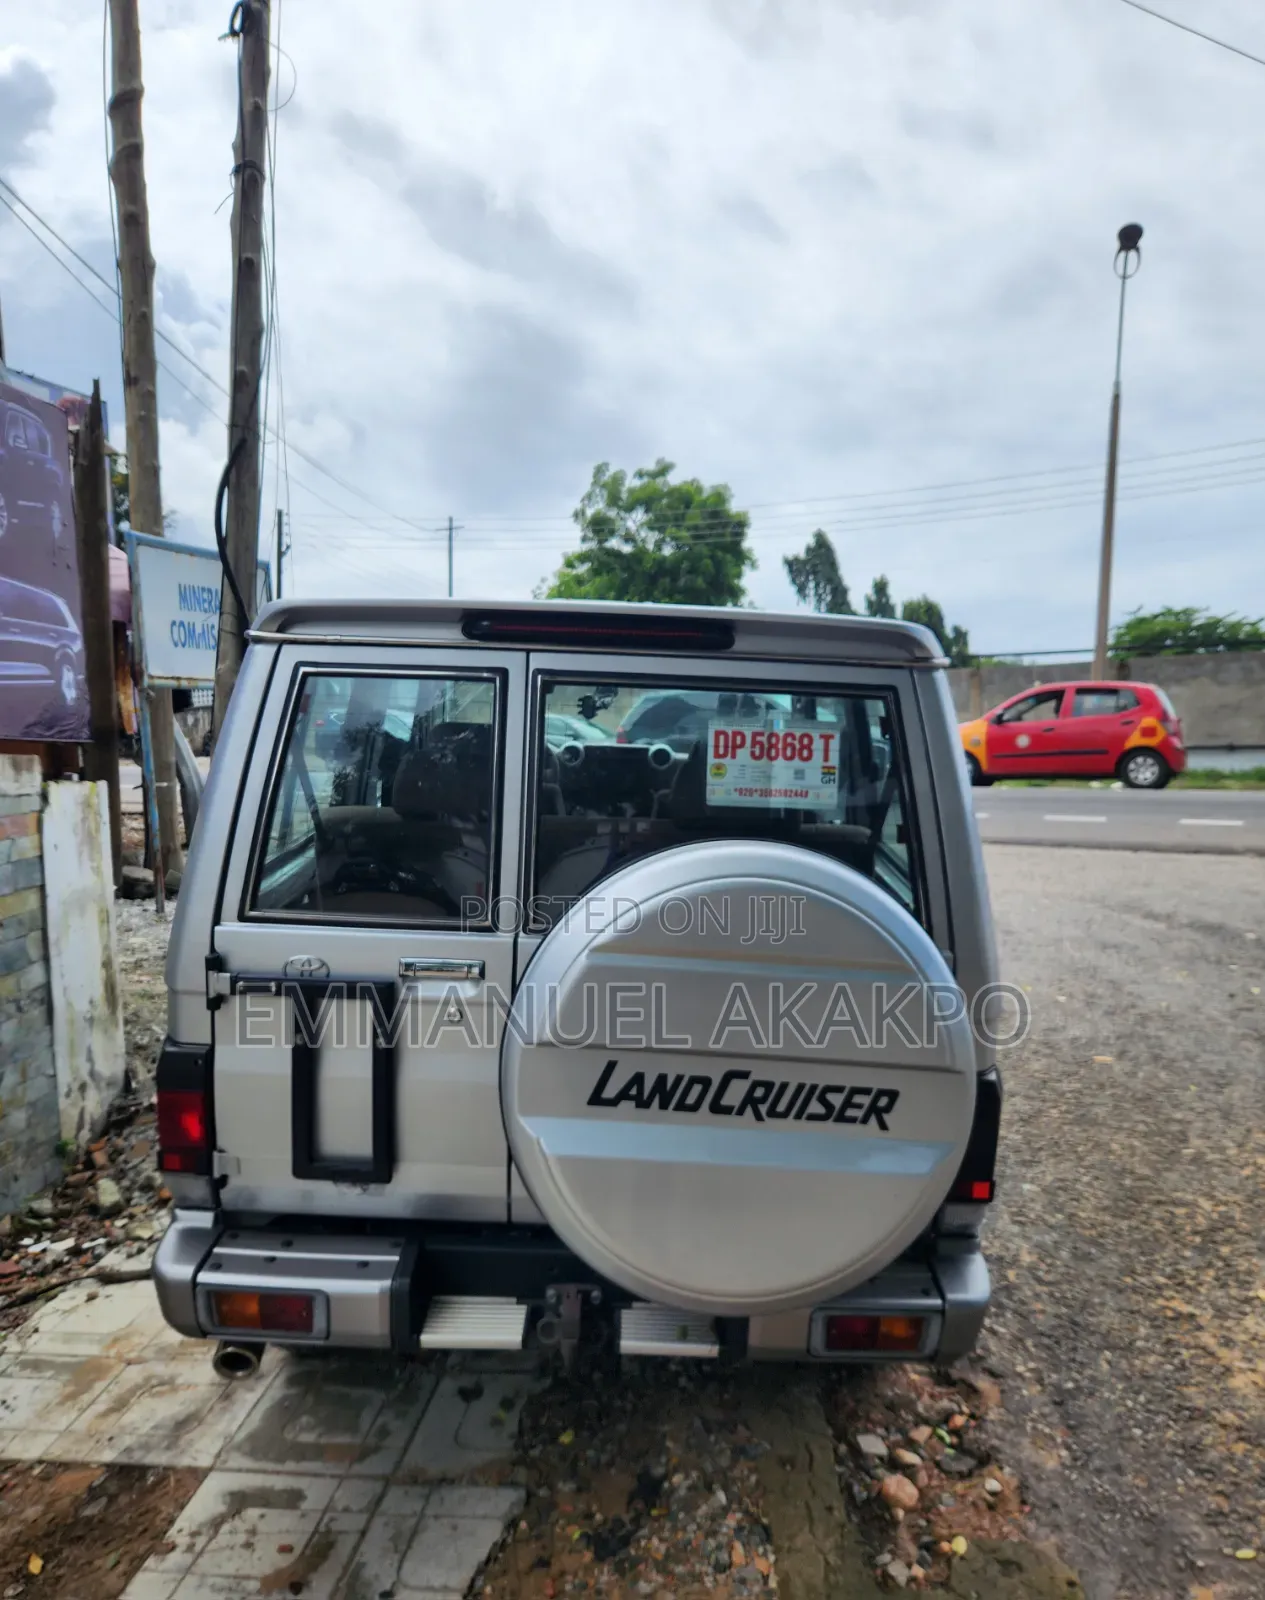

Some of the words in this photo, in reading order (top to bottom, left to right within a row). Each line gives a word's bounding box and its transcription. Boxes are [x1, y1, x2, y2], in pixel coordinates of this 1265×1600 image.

[713, 730, 746, 759] DP
[749, 731, 814, 762] 5868
[819, 734, 835, 762] T
[820, 775, 836, 785] GH
